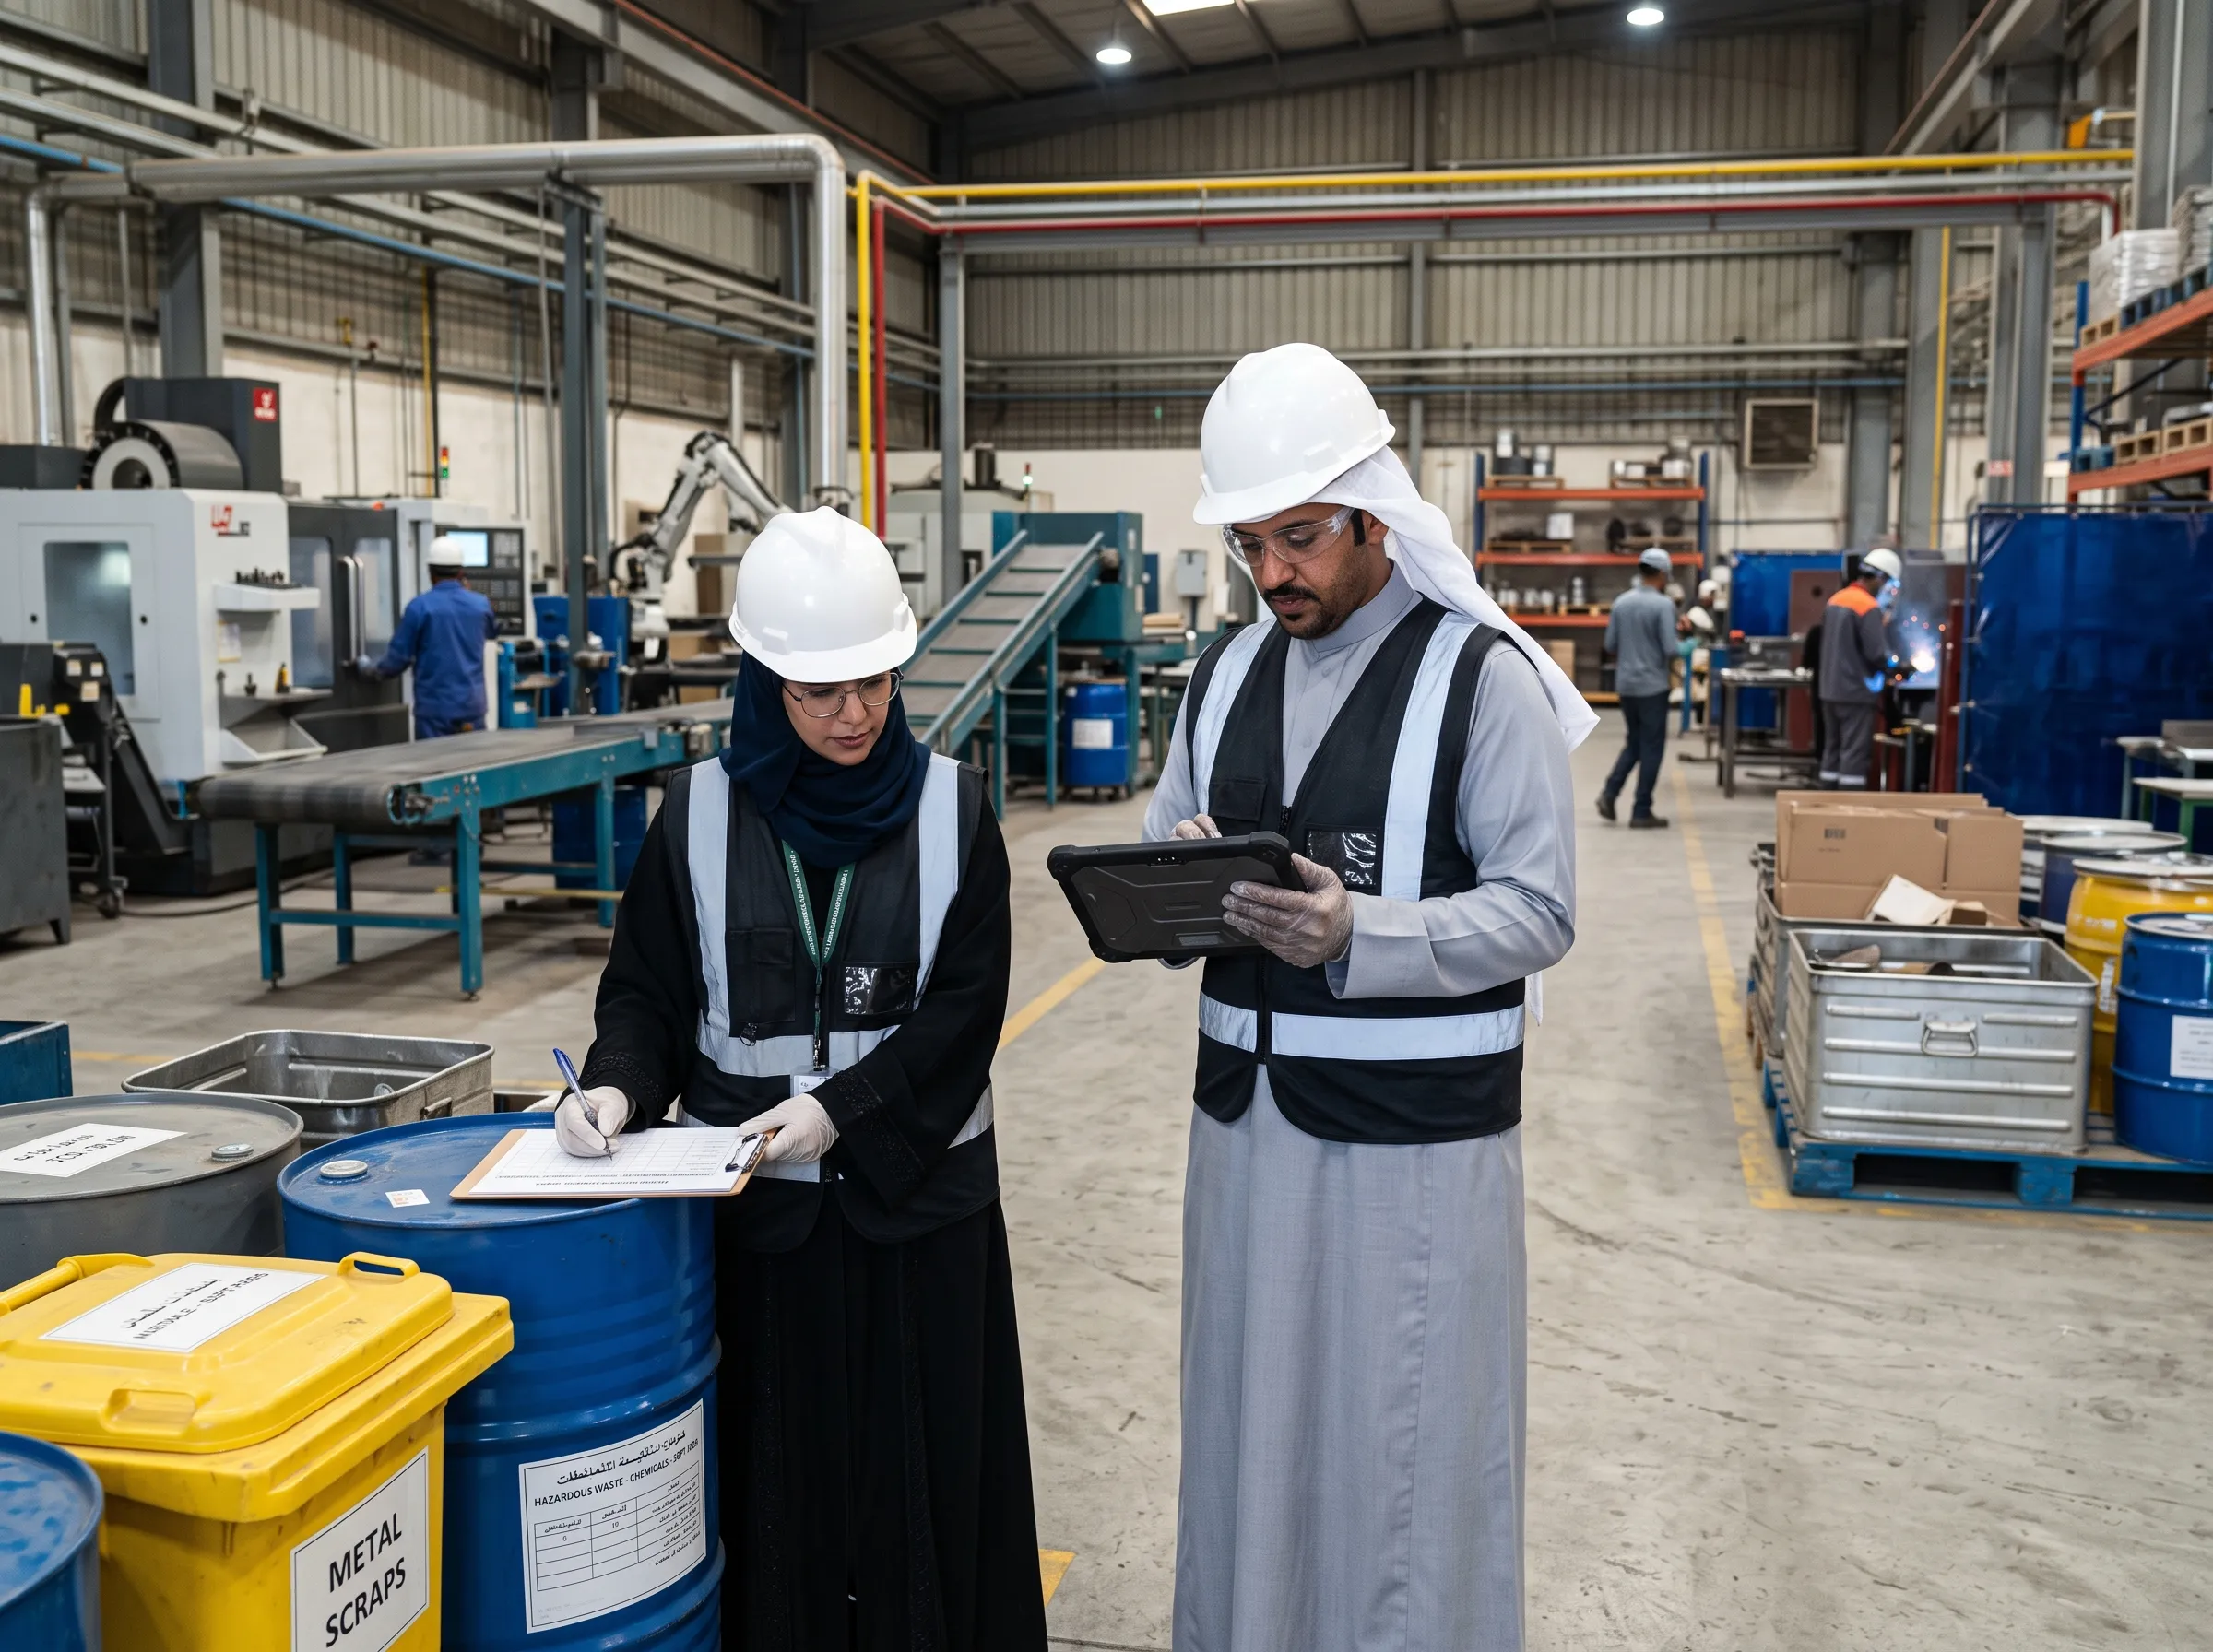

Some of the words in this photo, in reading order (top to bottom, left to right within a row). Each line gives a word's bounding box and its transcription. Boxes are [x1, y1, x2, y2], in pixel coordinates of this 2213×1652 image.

[534, 1486, 593, 1507] HAZARDOUS
[594, 1477, 624, 1493] WASTE
[630, 1458, 669, 1482] CHEMICALS
[329, 1512, 402, 1593] METAL
[325, 1557, 406, 1648] SCRAPS
